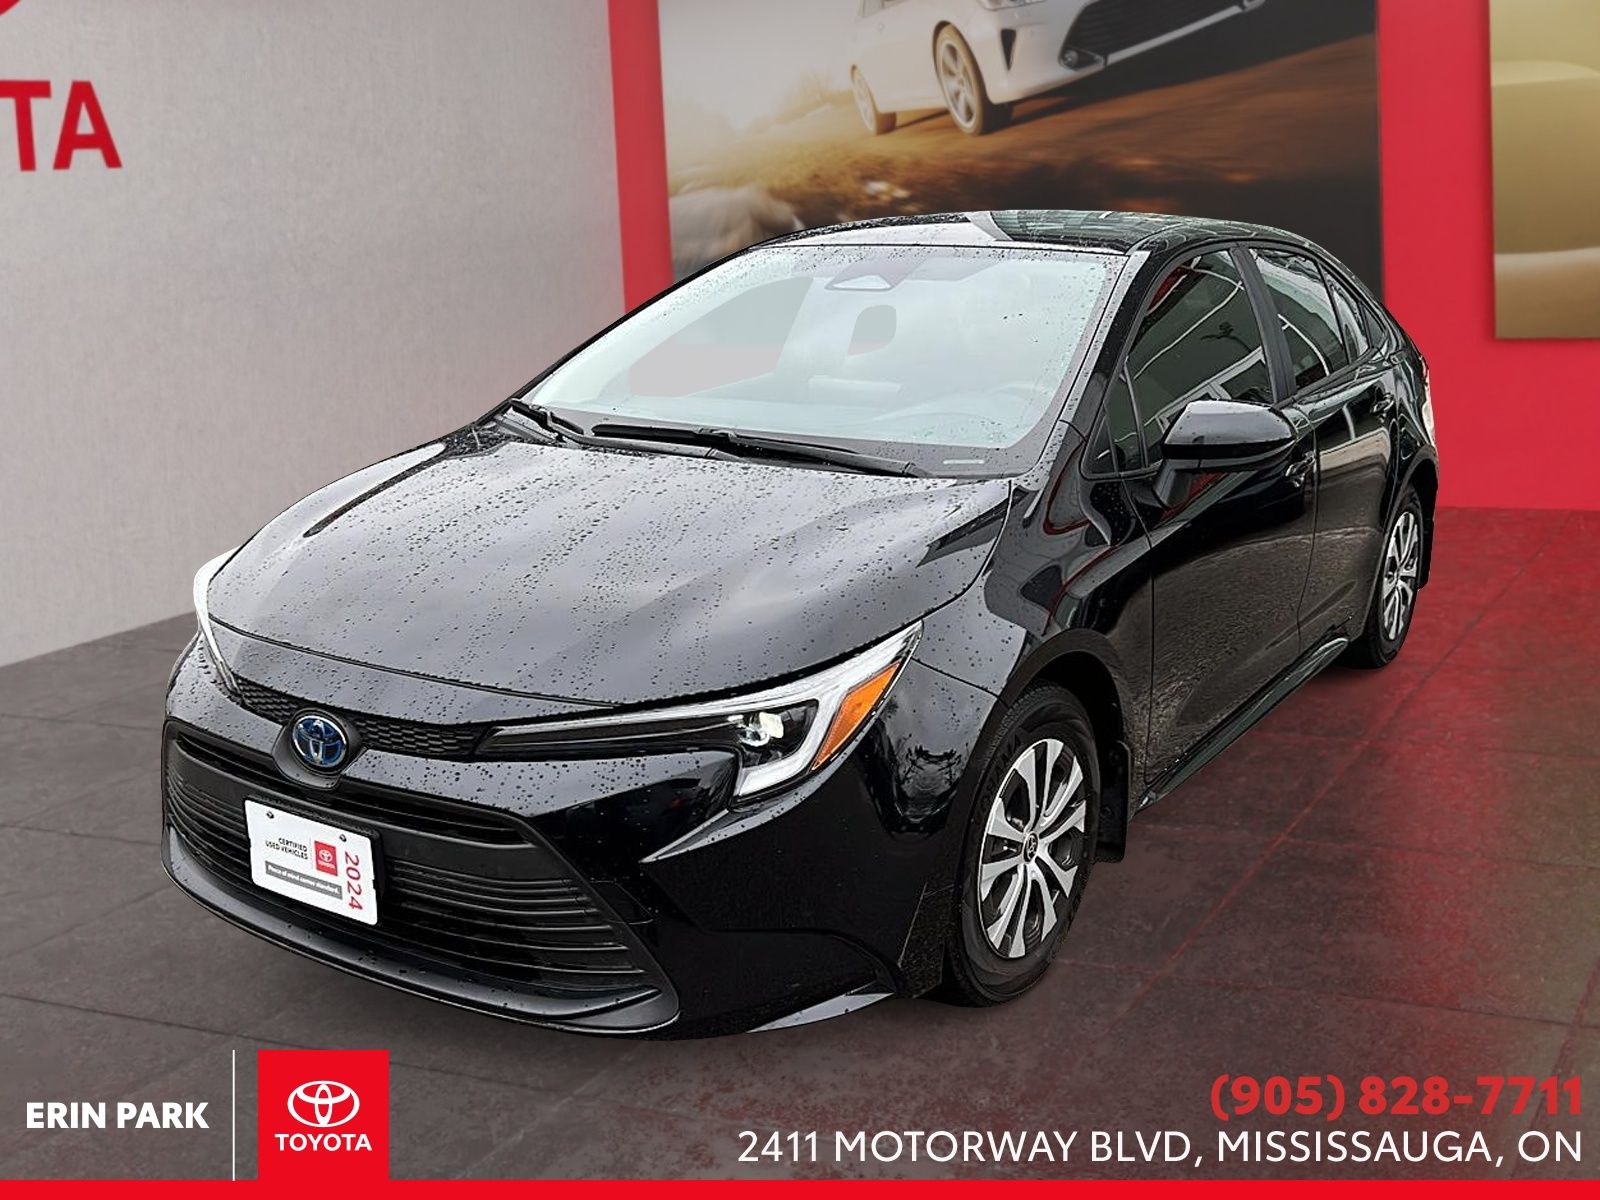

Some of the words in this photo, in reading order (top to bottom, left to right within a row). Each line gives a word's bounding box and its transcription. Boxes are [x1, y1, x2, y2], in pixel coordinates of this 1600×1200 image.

[265, 841, 280, 850] USED
[281, 846, 308, 860] VEHICLES
[278, 837, 307, 852] CERTIFIED
[345, 851, 363, 910] 2024
